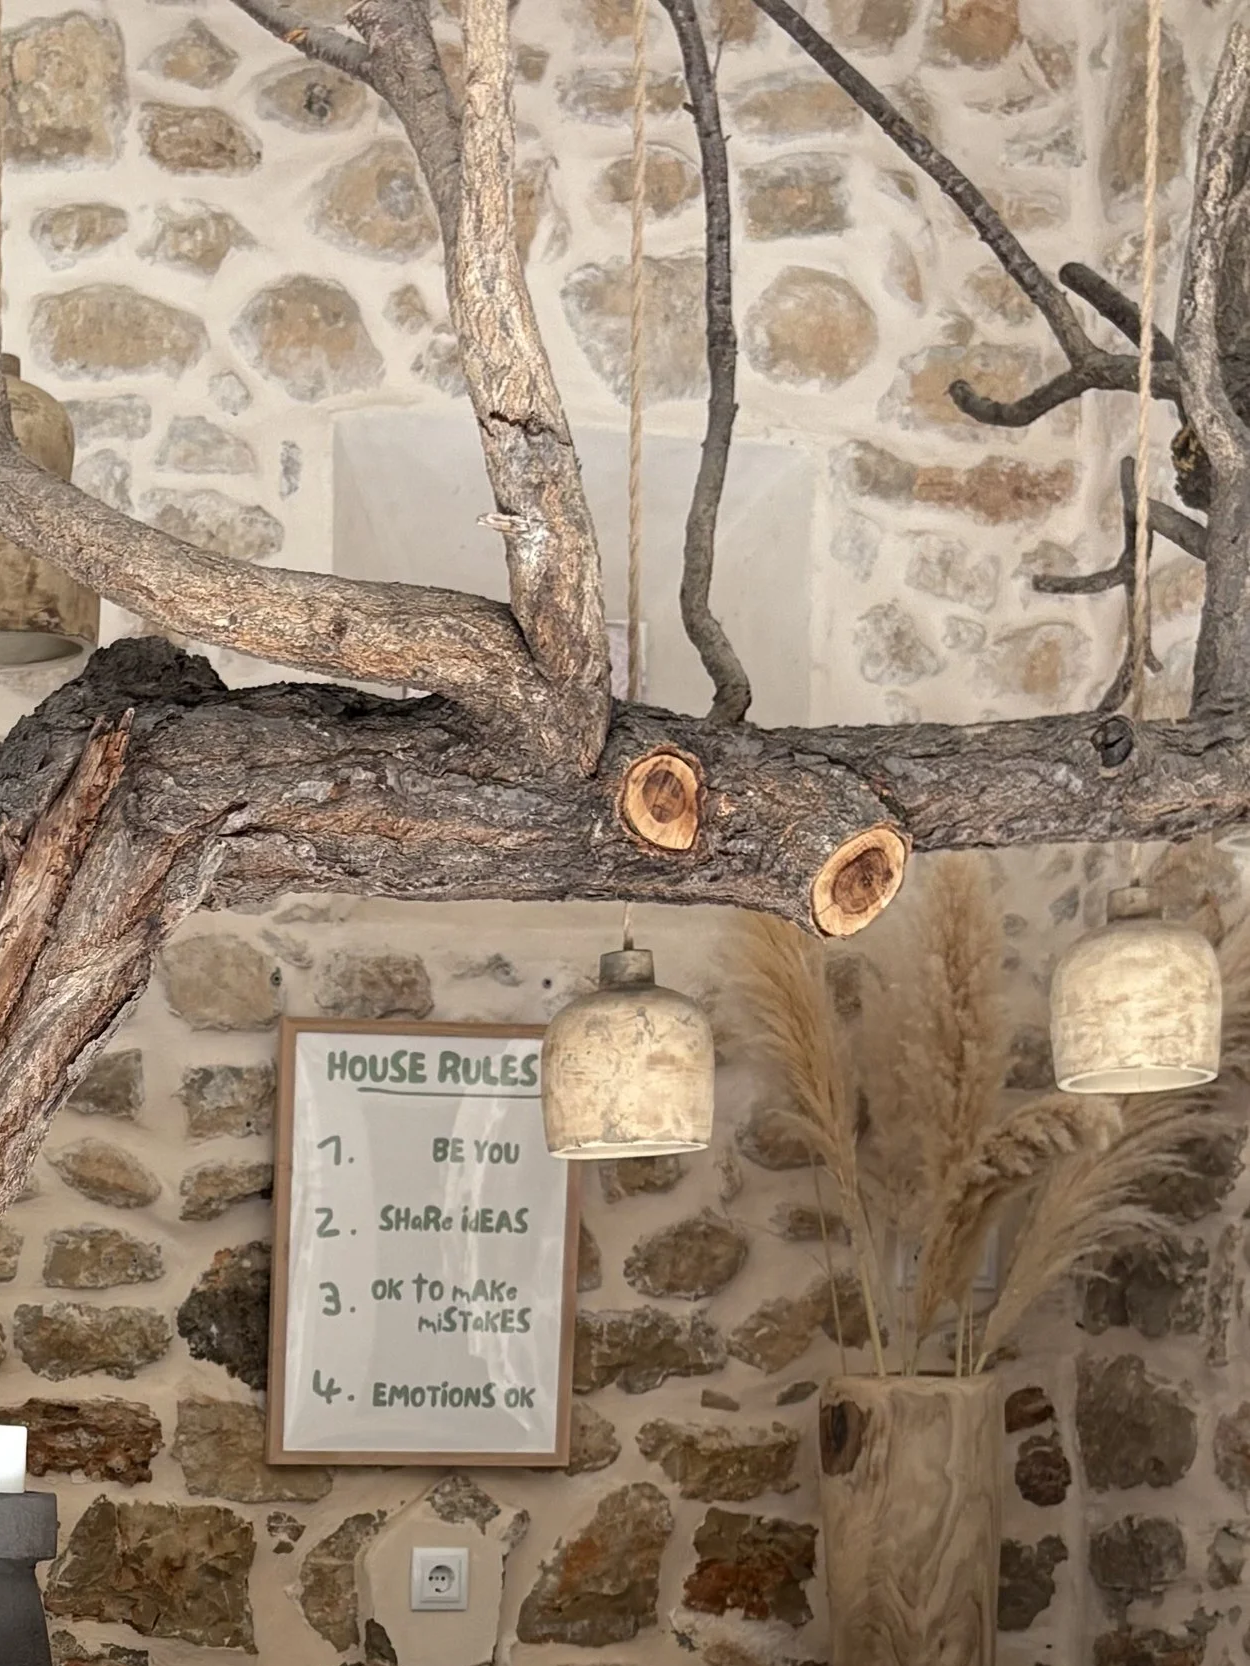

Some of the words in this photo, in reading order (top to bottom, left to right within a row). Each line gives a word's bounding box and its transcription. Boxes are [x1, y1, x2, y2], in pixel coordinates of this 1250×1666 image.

[327, 1050, 427, 1083] HOUSE
[437, 1050, 539, 1086] RULES
[317, 1135, 354, 1165] 1.
[432, 1137, 465, 1163] BE
[474, 1139, 520, 1164] YOU
[315, 1207, 356, 1238] 2.
[319, 1281, 356, 1316] 3.
[371, 1278, 403, 1300] OK
[504, 1386, 536, 1409] OK
